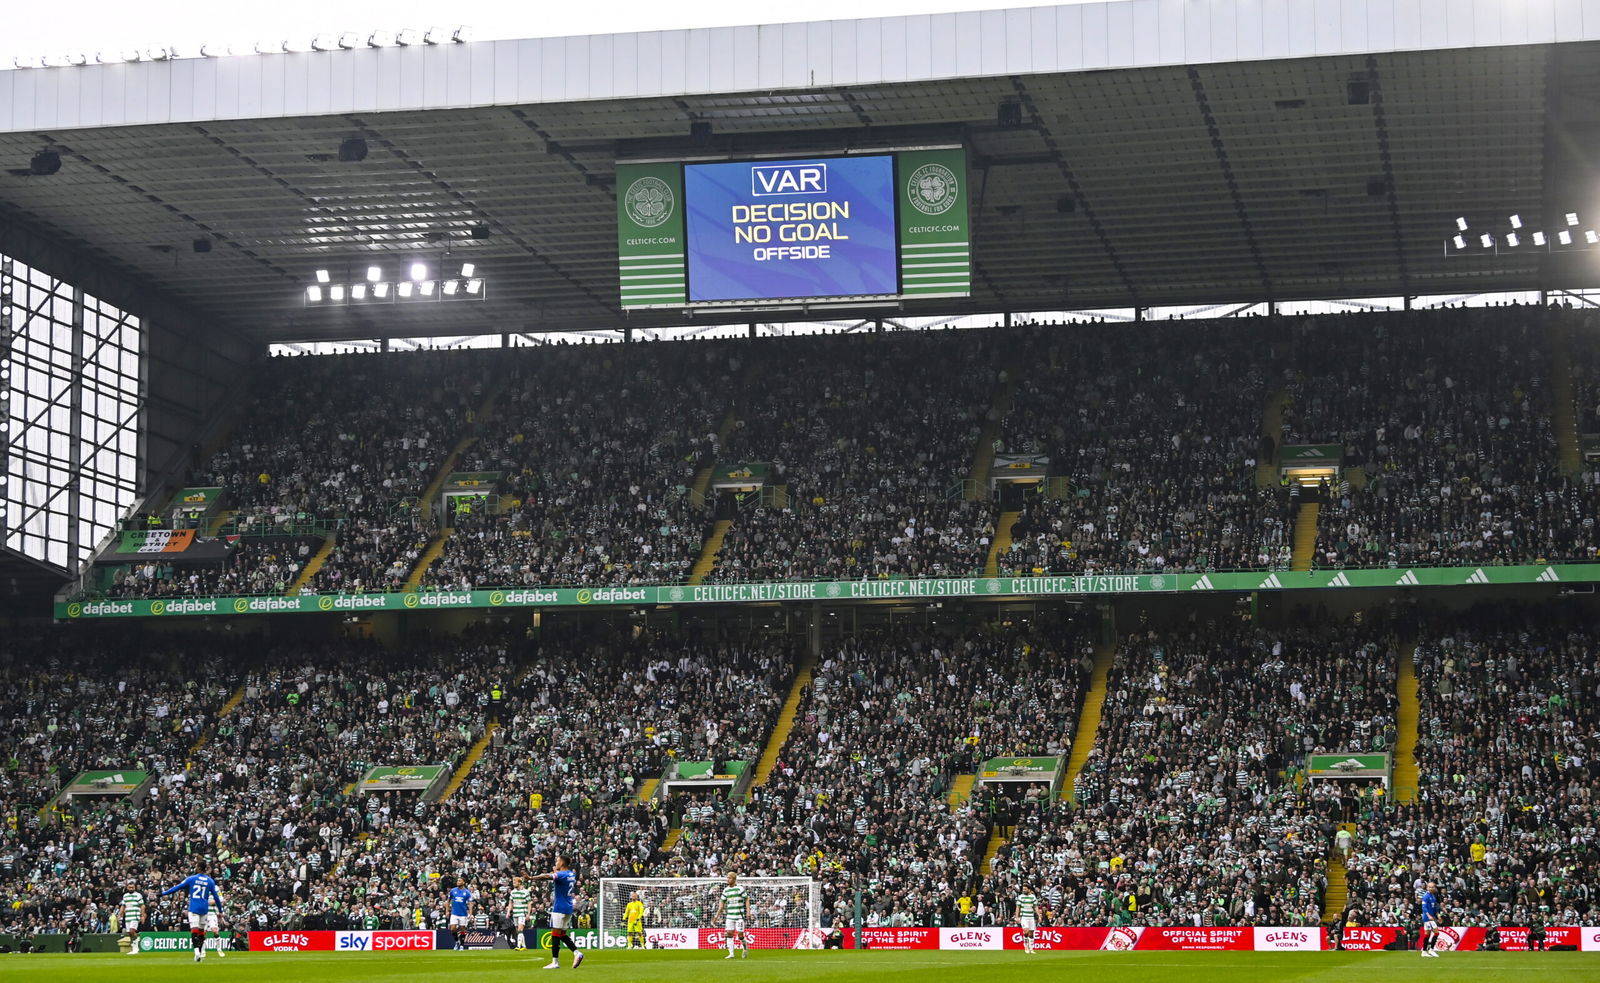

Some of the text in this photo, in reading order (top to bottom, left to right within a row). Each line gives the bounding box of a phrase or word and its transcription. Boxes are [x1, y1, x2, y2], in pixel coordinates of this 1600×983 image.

[757, 168, 822, 193] VAR
[731, 201, 849, 224] DECISION
[735, 222, 849, 244] NO GOAL
[909, 225, 960, 234] CELTICFC.COM
[626, 237, 676, 246] CELTICFC.COM
[753, 245, 831, 261] OFFSIDE
[130, 530, 187, 540] CREETOWN
[593, 588, 646, 602] dafabet
[694, 583, 816, 601] CELTICFC.NET/STORE
[851, 579, 976, 597] CELTICFC.NET/STORE
[249, 597, 301, 610] dafabet
[334, 595, 386, 609] dafabet
[419, 592, 472, 606] dafabet
[505, 590, 558, 604] dafabet
[82, 603, 133, 616] dafabet
[165, 600, 217, 613] dafabet
[192, 885, 208, 899] 21
[153, 937, 177, 949] CELTIC
[178, 937, 189, 949] FC
[263, 933, 309, 947] GLEN'S
[340, 932, 430, 950] sky sports
[648, 932, 688, 944] GLEN'S
[707, 931, 756, 944] GL'S
[950, 931, 992, 943] GLEN'S
[1011, 930, 1063, 943] GEN'S
[1265, 932, 1308, 943] GLEN'S
[1342, 930, 1382, 943] LEN'S
